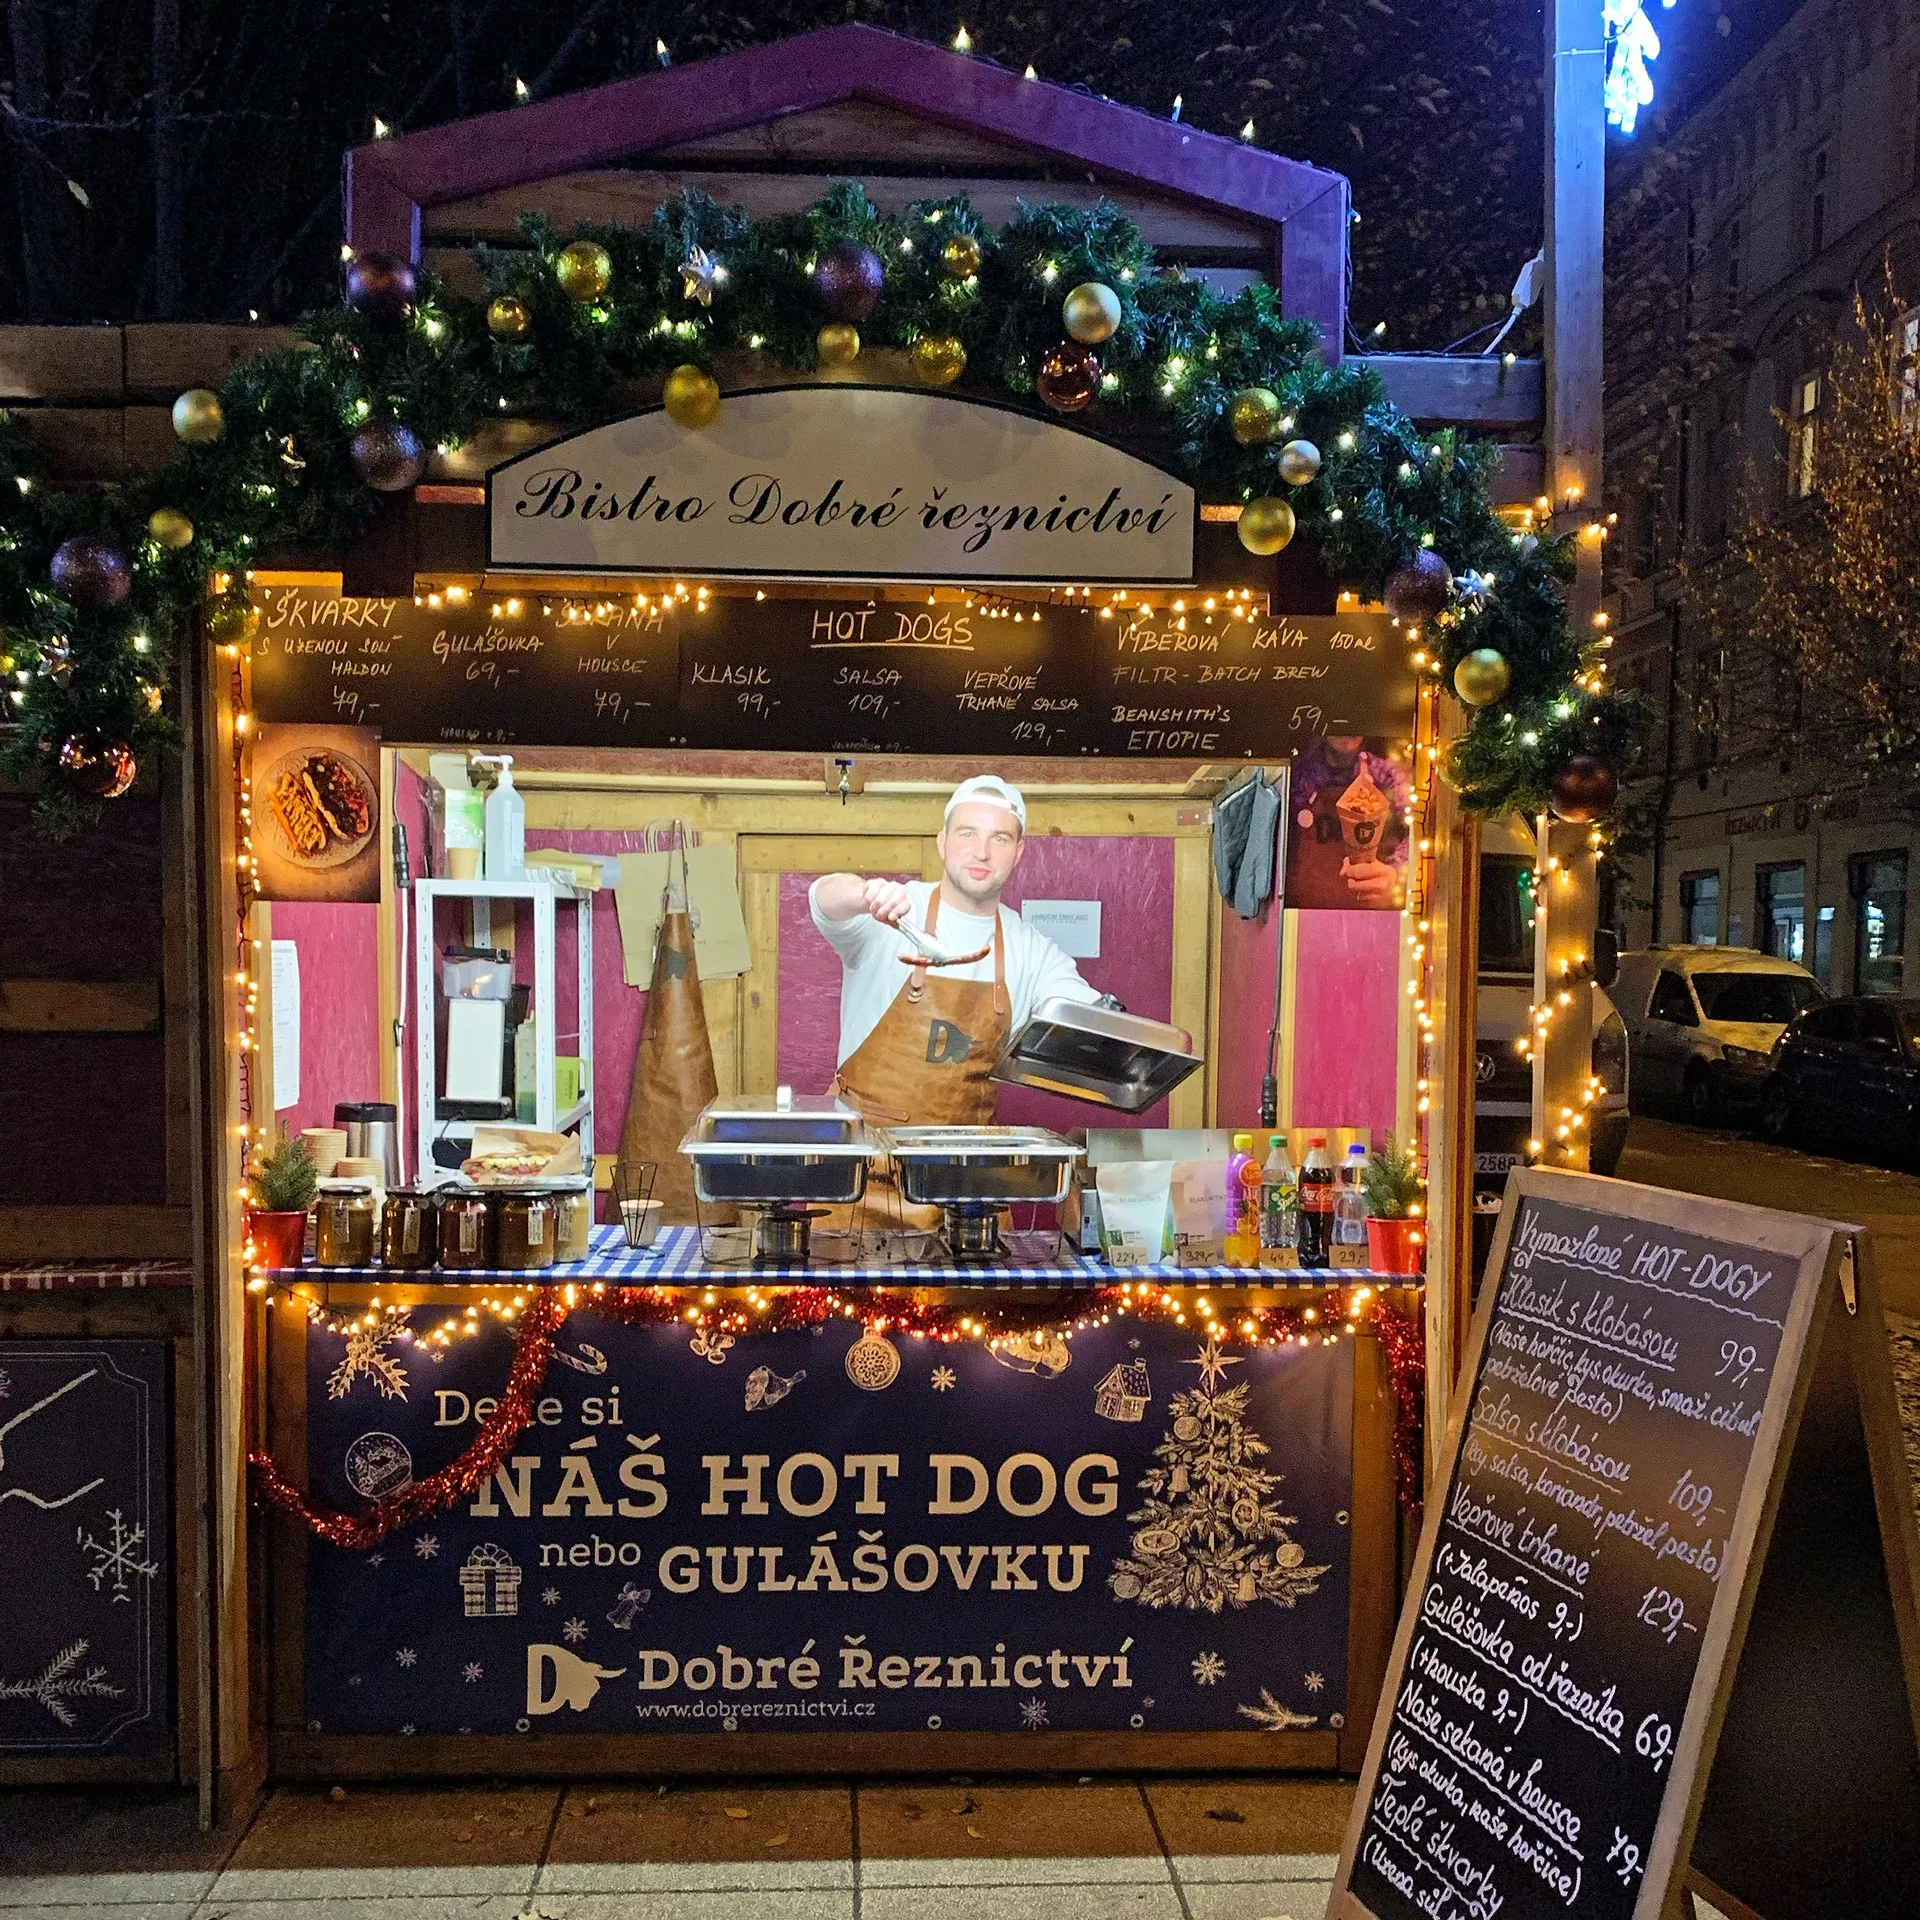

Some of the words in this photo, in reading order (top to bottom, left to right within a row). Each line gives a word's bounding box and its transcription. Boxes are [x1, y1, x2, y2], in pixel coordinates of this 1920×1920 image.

[516, 468, 716, 521] Bistro
[728, 473, 908, 530] Dobré
[916, 485, 1177, 555] řeznictví
[267, 587, 397, 629] ŠKVARKY
[811, 609, 877, 643] HOT
[885, 610, 973, 645] DOGS
[256, 636, 270, 656] S
[432, 625, 544, 665] GULÁŠOVKA
[606, 634, 620, 650] V
[1252, 618, 1309, 648] KÁVA
[578, 657, 647, 674] HOUSCE
[691, 662, 771, 686] KLASIK
[833, 667, 902, 686] SALSA
[964, 665, 1042, 691] VEPŘOVÉ
[1198, 664, 1260, 683] BATCH
[1272, 664, 1329, 681] BREW
[956, 692, 1021, 711] TRHANÉ
[1031, 697, 1079, 711] SALSA
[1128, 730, 1220, 750] ETIOPIE
[1513, 1209, 1633, 1269] Vymazlené
[1500, 1271, 1567, 1322] Klasik
[1566, 1301, 1580, 1326] s
[1581, 1290, 1679, 1362] klobásou
[434, 1389, 563, 1427] Dee
[581, 1386, 623, 1427] si
[1525, 1421, 1538, 1443] s
[1538, 1412, 1631, 1481] klobásou
[470, 1433, 667, 1518] NÁŠ
[701, 1452, 898, 1518] HOT
[929, 1453, 1119, 1518] DOG
[1450, 1481, 1526, 1547] Vepřové
[1517, 1518, 1600, 1586] trhané
[540, 1534, 641, 1567] nebo
[658, 1529, 1090, 1593] GULÁŠOVKU
[1424, 1583, 1514, 1665] Gulášovka
[638, 1639, 820, 1690] Dobré
[839, 1634, 1133, 1689] Řeznictví
[636, 1699, 876, 1718] www.dobrereznictvi.cz
[1398, 1679, 1441, 1733] Naše
[1506, 1770, 1521, 1790] v
[1518, 1759, 1581, 1841] housce
[1468, 1800, 1509, 1841] naše
[1374, 1773, 1437, 1842] Teplé
[1427, 1820, 1504, 1920] škvarky
